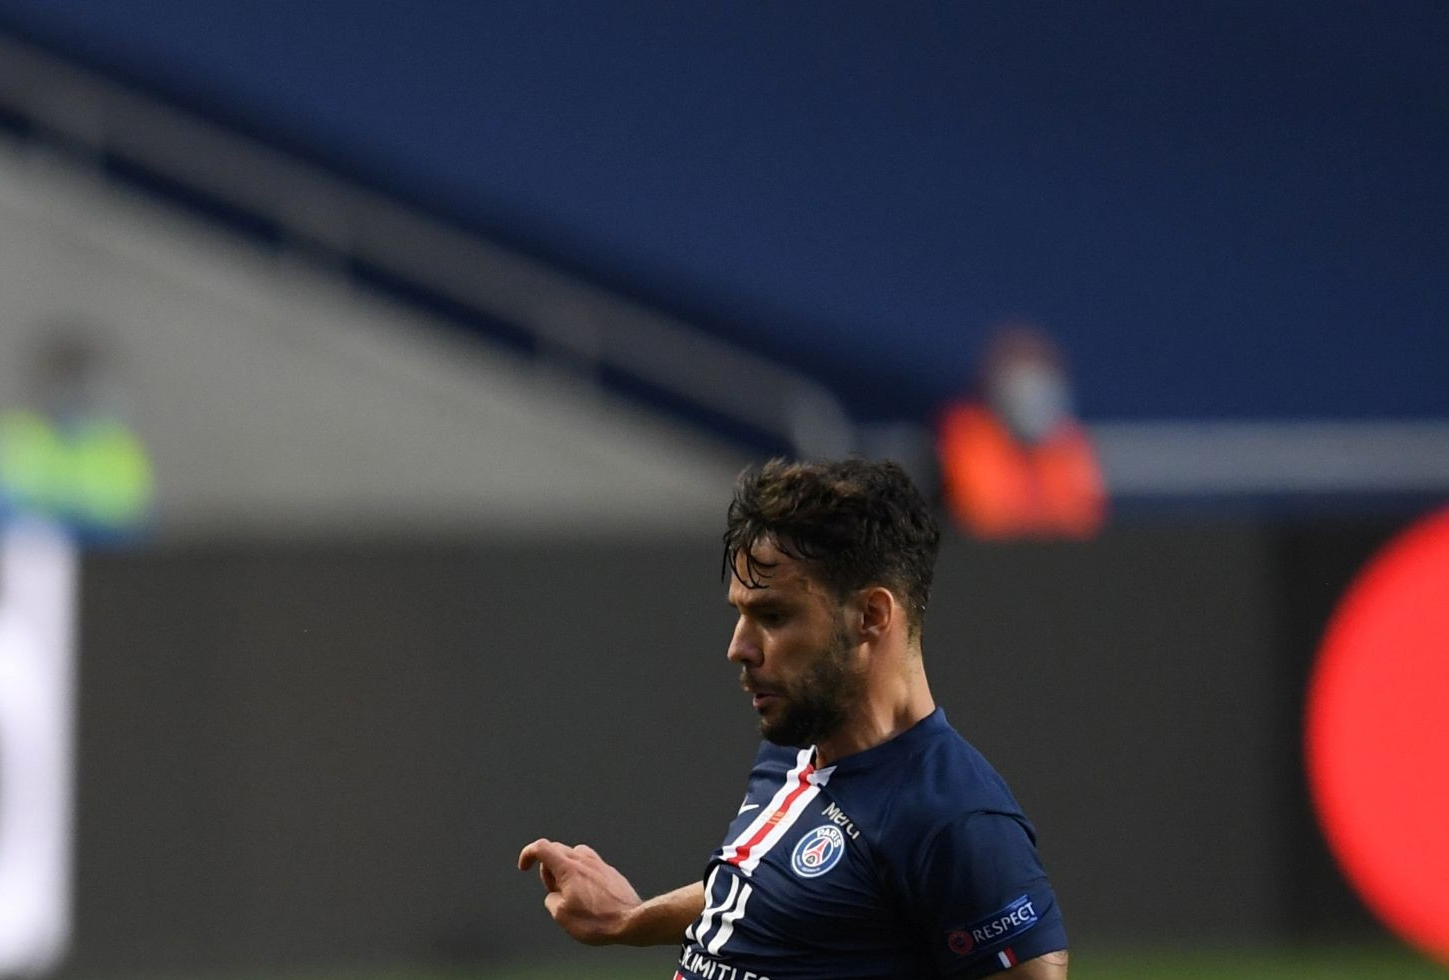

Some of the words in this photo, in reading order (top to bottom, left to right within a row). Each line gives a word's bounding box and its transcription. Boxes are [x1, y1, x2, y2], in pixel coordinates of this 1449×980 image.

[816, 828, 842, 848] PARIS
[821, 801, 860, 840] Merci
[973, 901, 1036, 942] RESPECT
